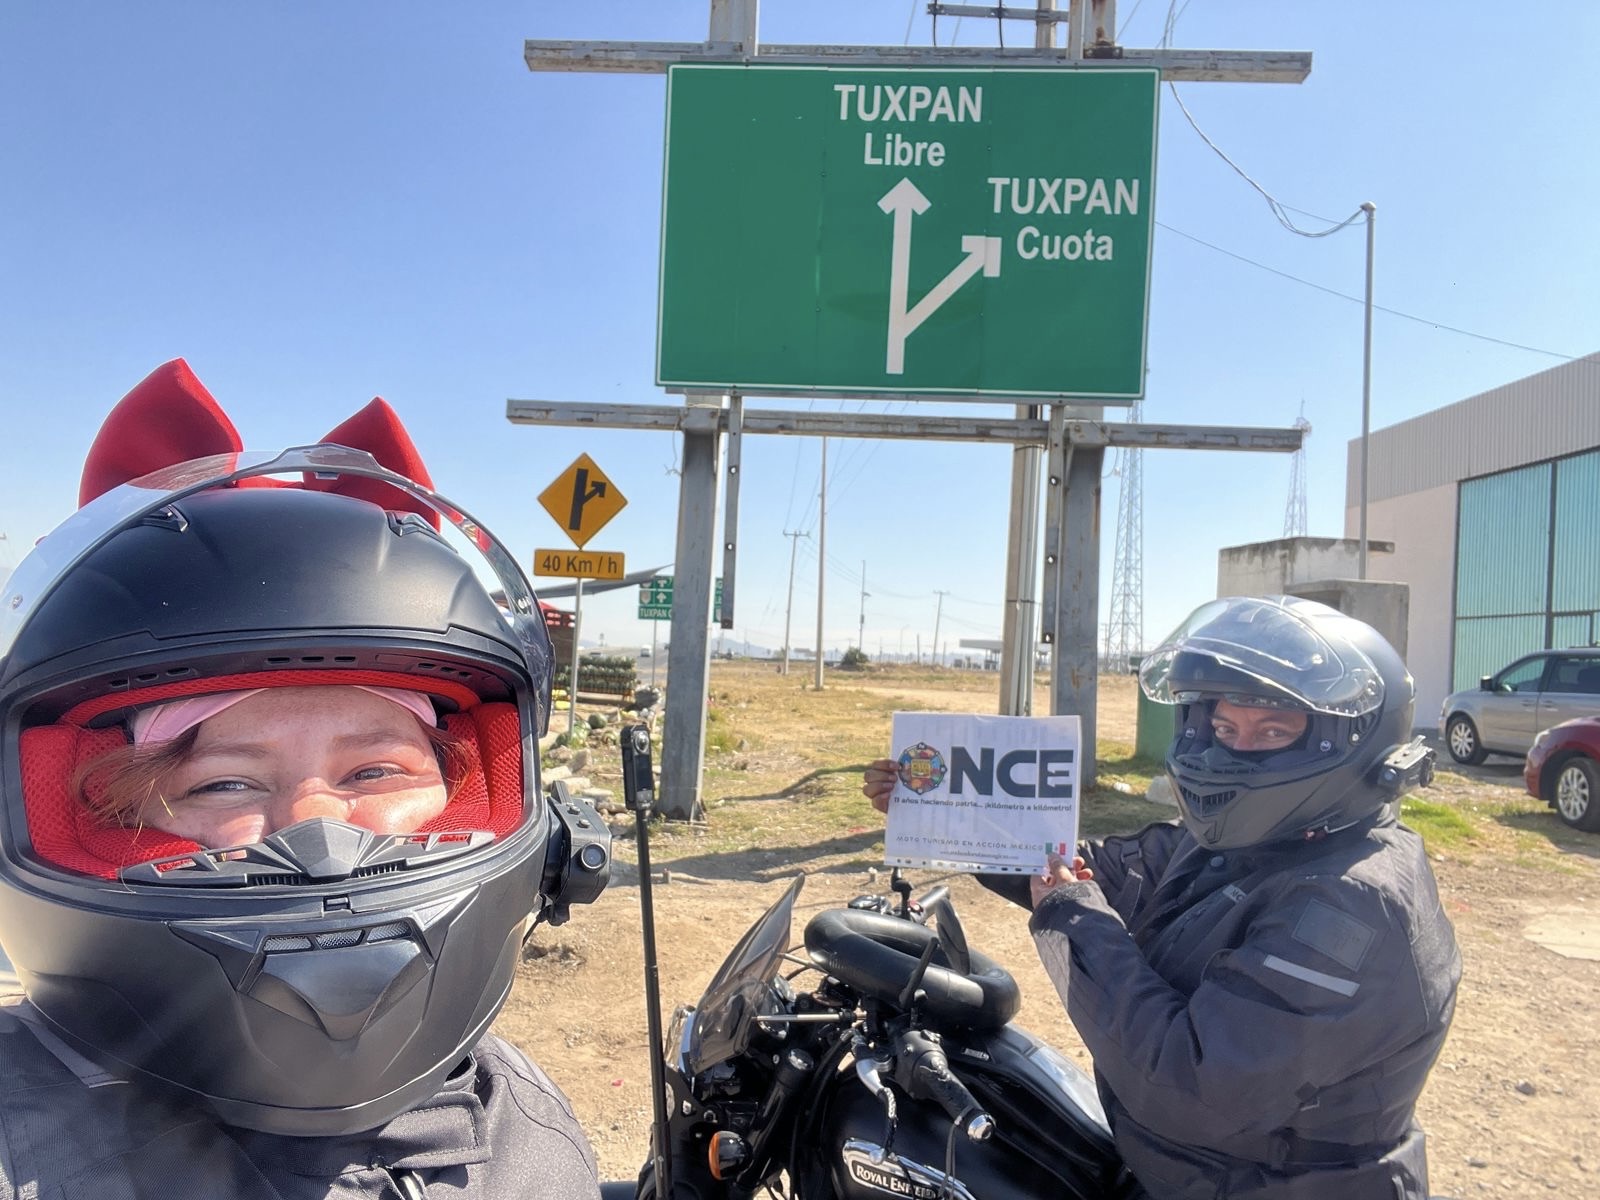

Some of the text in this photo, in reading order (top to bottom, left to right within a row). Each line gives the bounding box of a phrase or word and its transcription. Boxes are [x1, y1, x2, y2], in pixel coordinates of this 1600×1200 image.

[834, 84, 982, 123] TUXPAN
[864, 133, 945, 167] Libre
[988, 177, 1139, 215] TUXPAN
[1016, 226, 1112, 262] Cuota
[542, 556, 561, 573] 40
[640, 608, 667, 618] TUXPAN
[901, 797, 919, 805] años
[922, 837, 959, 846] TURISMO
[856, 1165, 889, 1187] ROYAL
